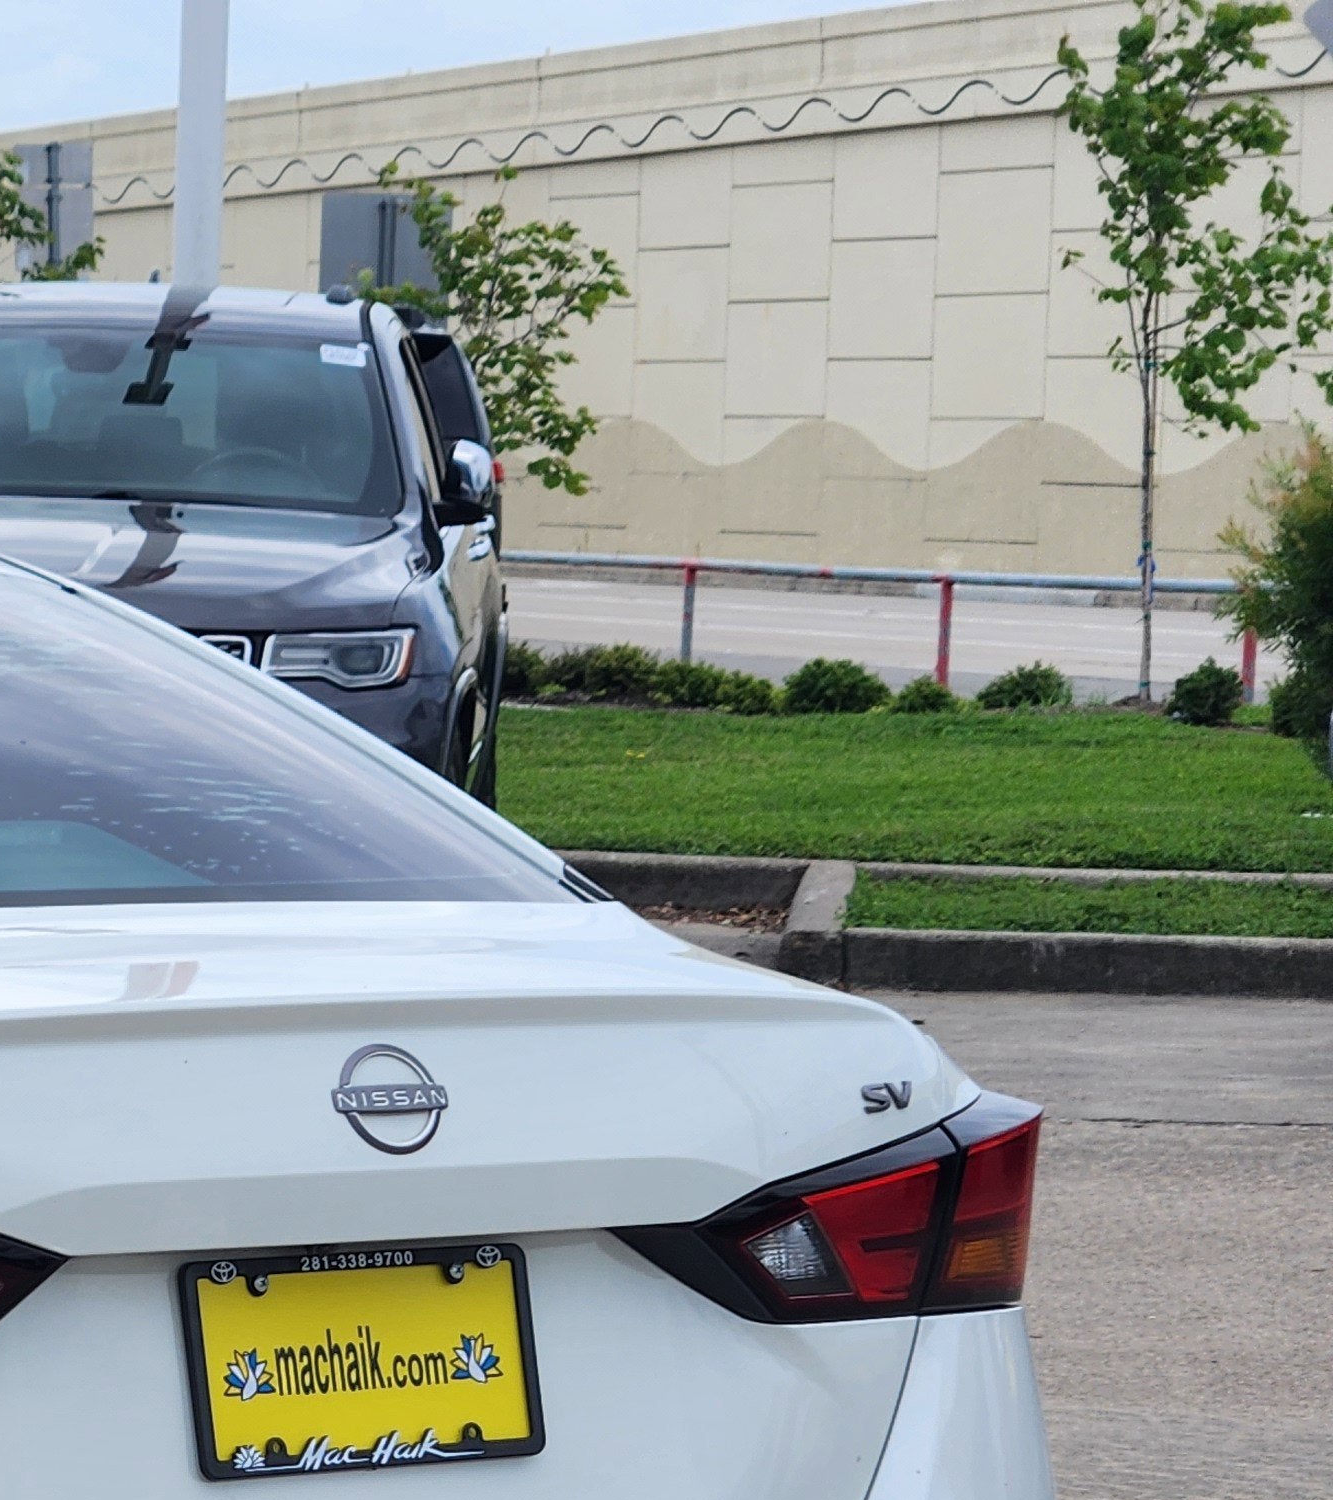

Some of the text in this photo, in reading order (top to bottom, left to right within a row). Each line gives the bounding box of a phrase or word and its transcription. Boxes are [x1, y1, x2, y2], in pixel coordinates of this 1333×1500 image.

[336, 1089, 447, 1108] NISSAN
[860, 1080, 912, 1115] SV
[300, 1250, 413, 1272] 281-338-9700
[274, 1324, 449, 1397] machaik.com
[289, 1428, 455, 1472] Mac Haik
